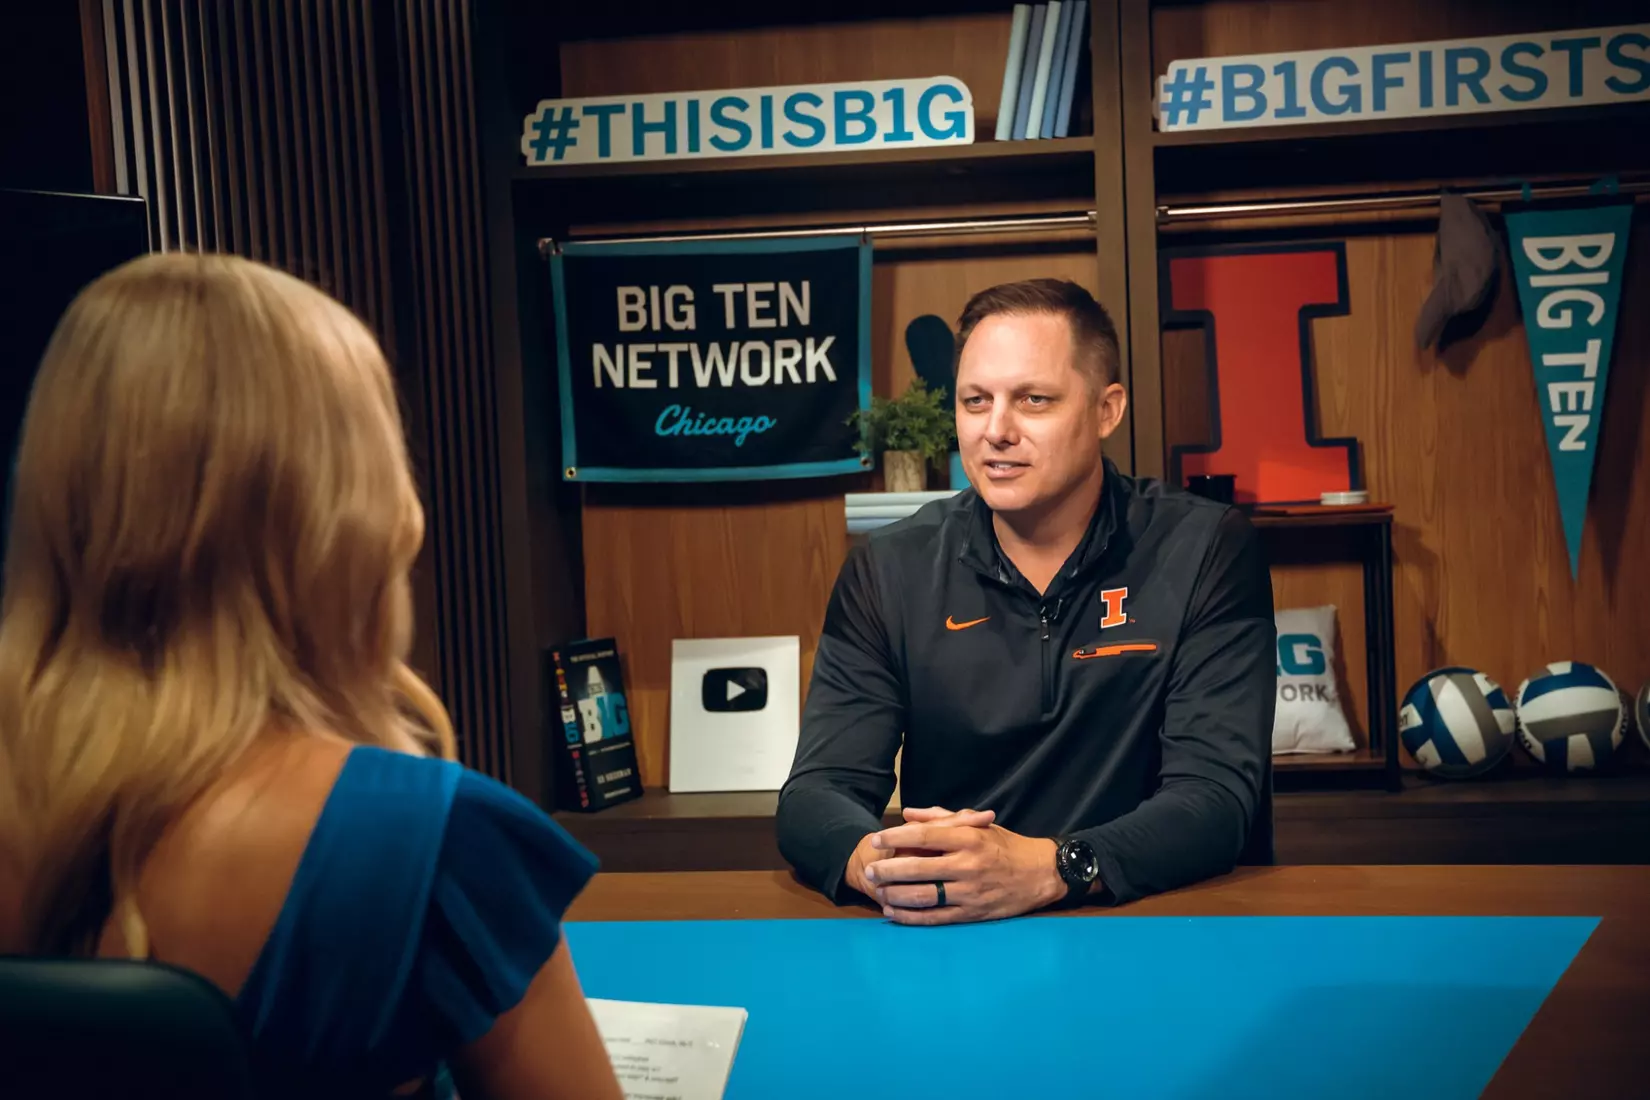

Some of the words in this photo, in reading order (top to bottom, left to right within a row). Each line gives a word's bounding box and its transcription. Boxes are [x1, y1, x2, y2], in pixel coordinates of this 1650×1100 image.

[1160, 33, 1650, 126] #B1GFIRSTS
[529, 84, 967, 162] #THISISB1G
[617, 285, 696, 332] BIG
[712, 280, 811, 329] TEN
[1522, 232, 1615, 329] BIG
[592, 335, 837, 389] NETWORK
[1542, 339, 1602, 451] TEN
[655, 404, 777, 447] Chicago
[1280, 683, 1329, 702] ORK
